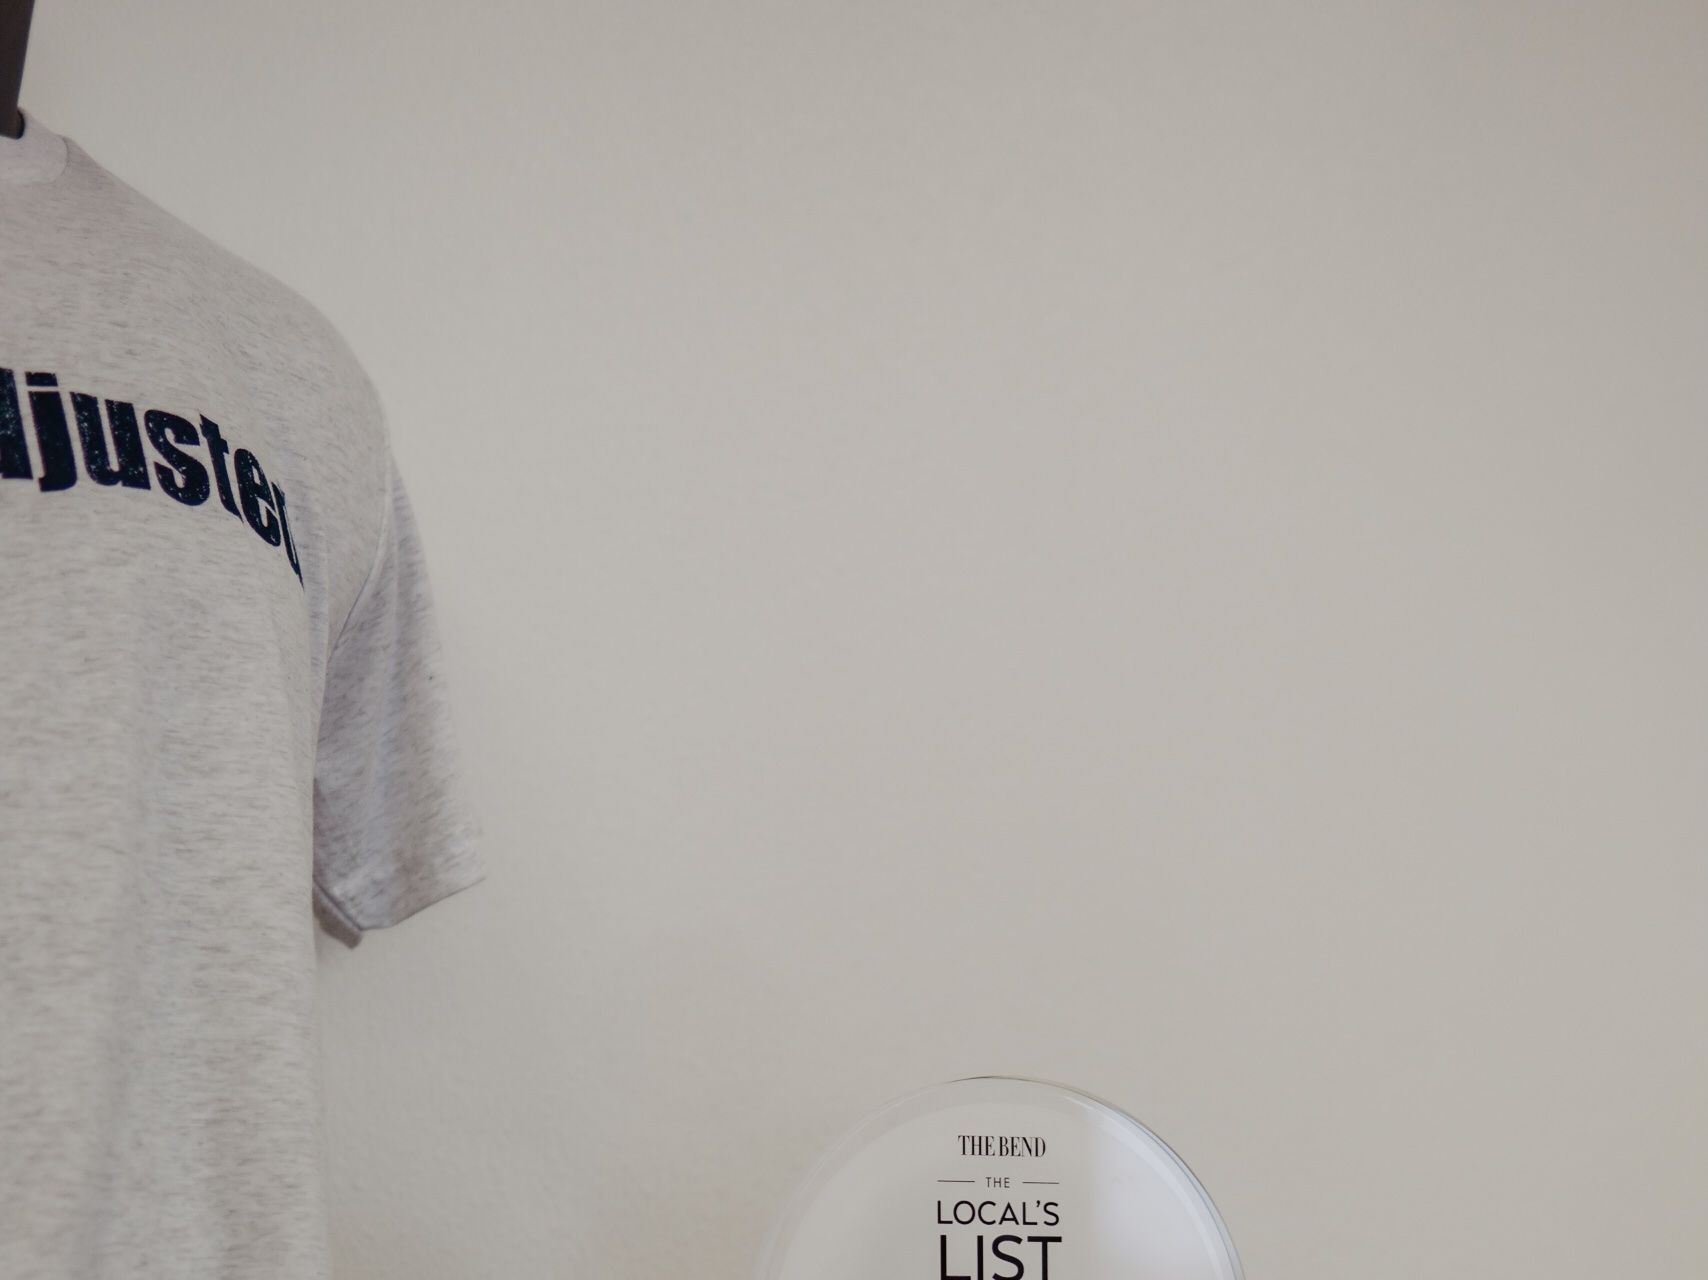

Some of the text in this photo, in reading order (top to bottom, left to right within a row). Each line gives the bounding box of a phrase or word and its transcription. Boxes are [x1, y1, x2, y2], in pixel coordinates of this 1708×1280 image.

[957, 1135, 1047, 1158] THE BEND
[985, 1176, 1010, 1189] THE
